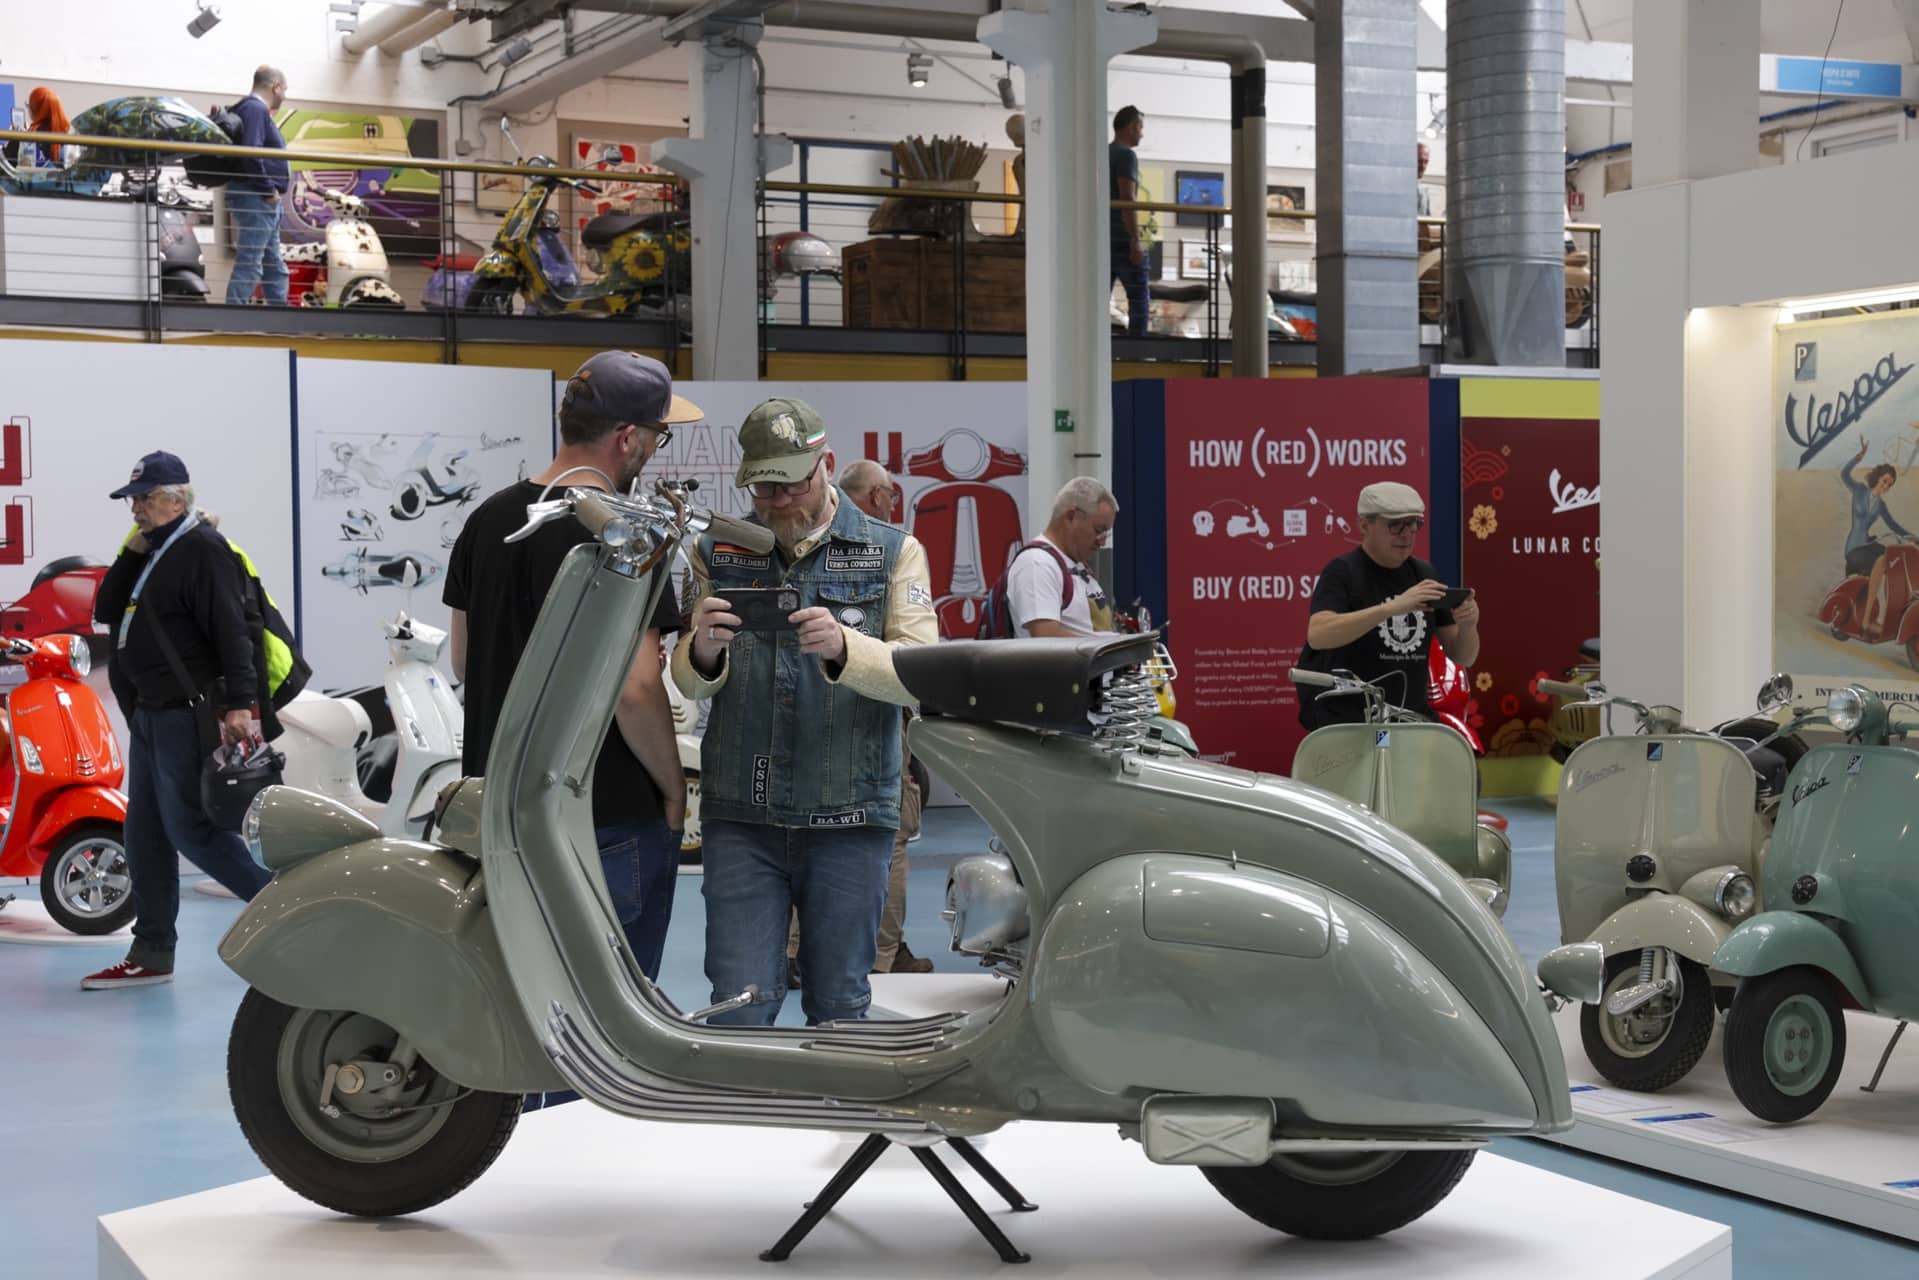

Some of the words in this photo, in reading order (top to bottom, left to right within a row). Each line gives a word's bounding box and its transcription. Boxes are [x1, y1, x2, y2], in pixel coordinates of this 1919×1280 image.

[1785, 351, 1915, 469] Vespa
[1189, 440, 1243, 467] HOW
[1251, 426, 1321, 478] (RED)
[1325, 439, 1407, 466] WORKS
[1512, 536, 1570, 554] LUNAR
[829, 561, 849, 569] VESPA
[850, 560, 881, 568] COWBOYS
[1192, 576, 1233, 600] BUY
[1239, 575, 1294, 602] (RED)
